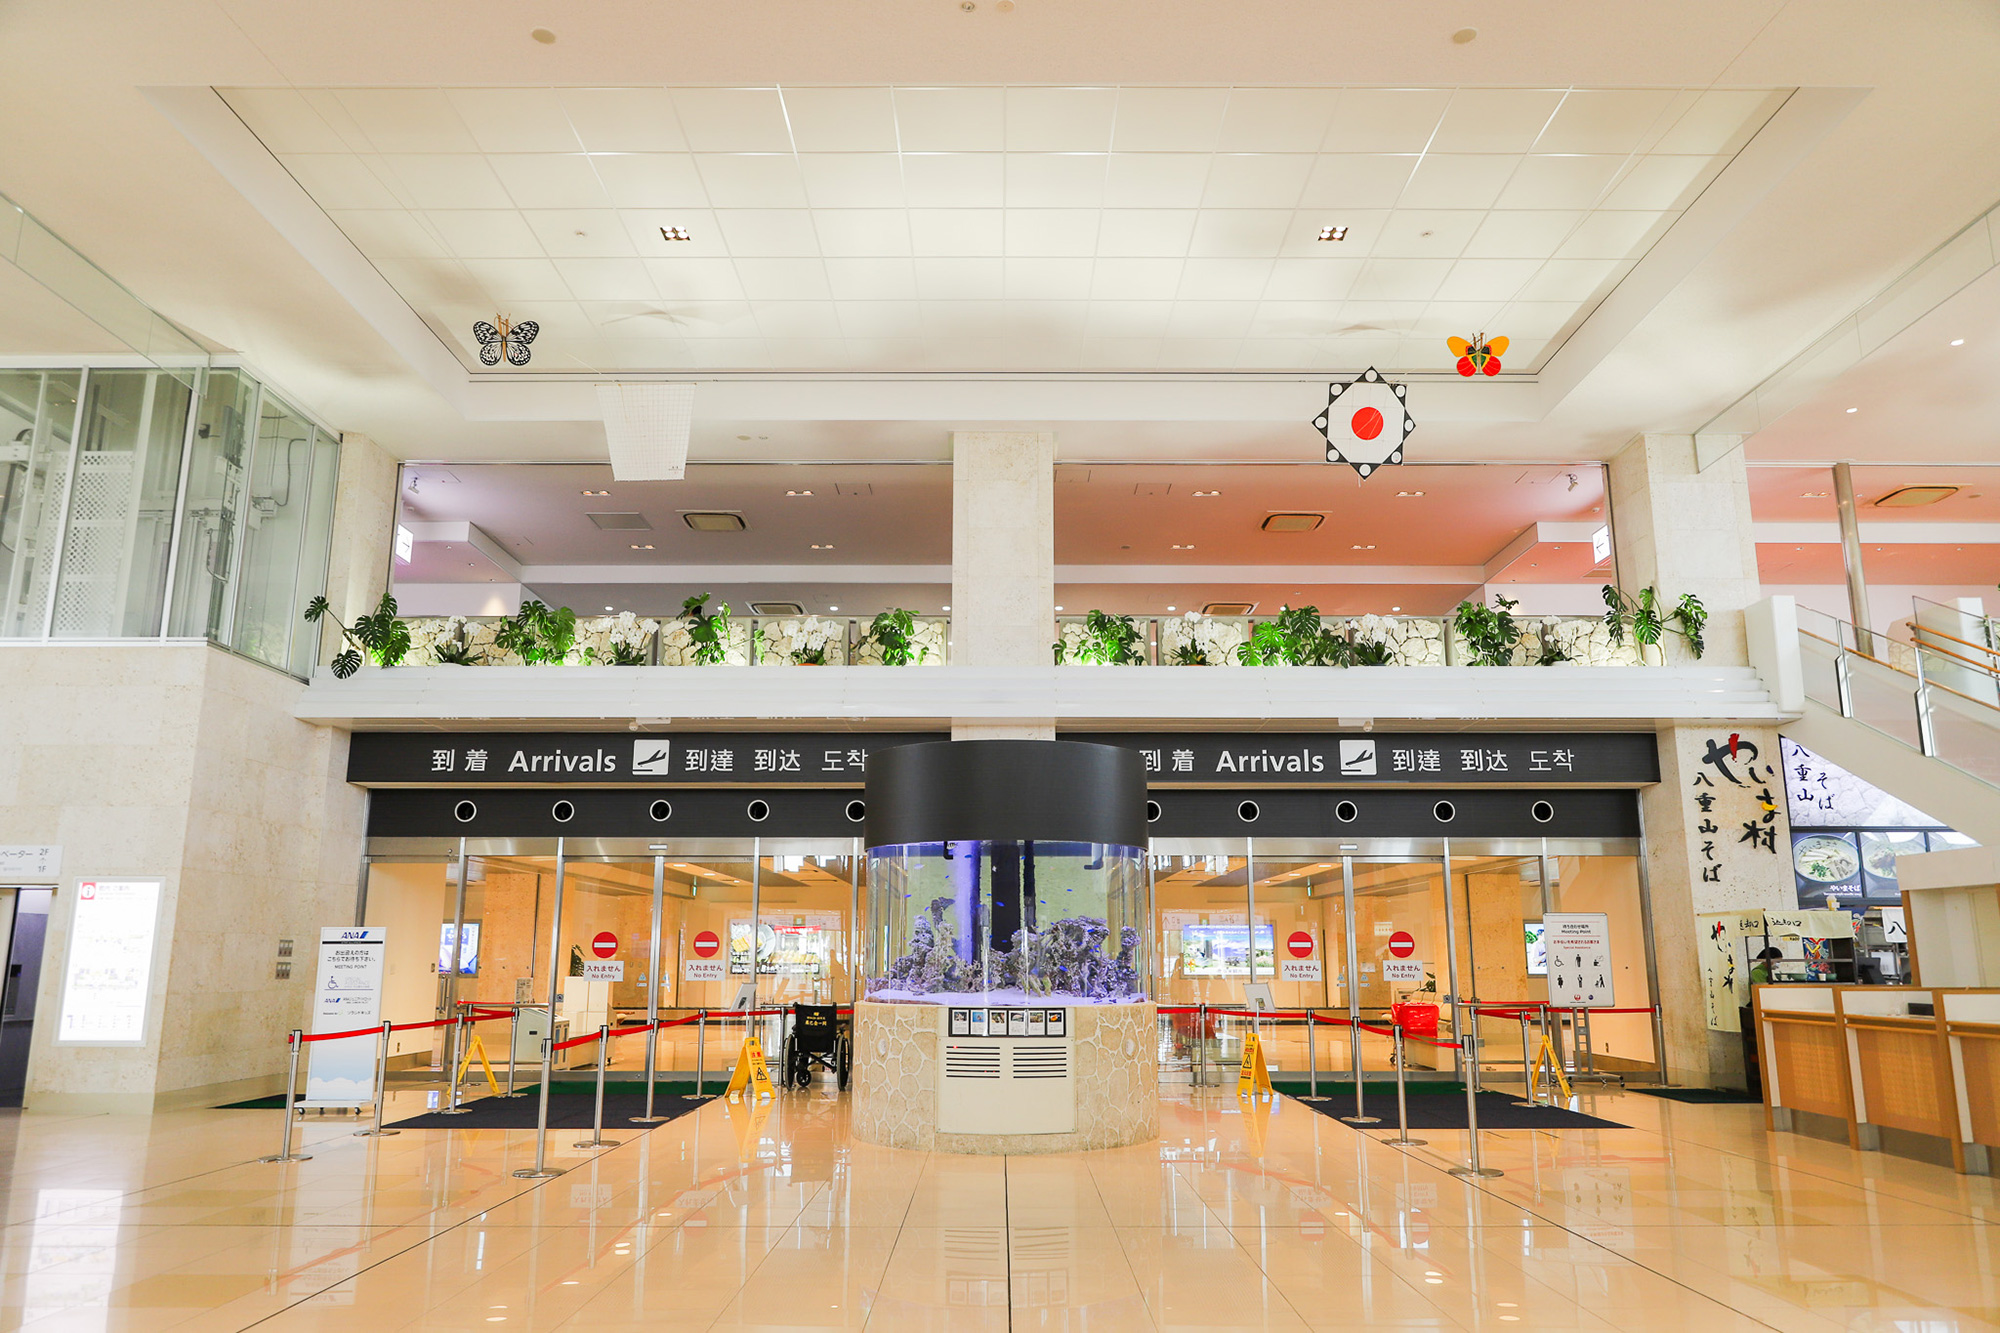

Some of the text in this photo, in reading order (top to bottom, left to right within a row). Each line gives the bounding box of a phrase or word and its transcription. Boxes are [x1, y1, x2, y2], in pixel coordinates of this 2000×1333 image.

[507, 750, 616, 772] Arrivals
[685, 749, 733, 772] 到達
[754, 749, 800, 772] 到达
[821, 749, 868, 772] 도착
[1216, 750, 1324, 772] Arrivals
[1392, 749, 1441, 772] 到達
[1460, 749, 1508, 772] 到达
[1529, 749, 1575, 772] 도착
[1792, 745, 1814, 802] 八重山
[1816, 772, 1835, 810] そば
[1693, 772, 1722, 882] 八重山そば
[40, 848, 49, 856] 2F
[38, 865, 47, 873] 1F
[1830, 884, 1860, 892] やいまそば
[341, 931, 360, 939] ANA
[1284, 964, 1319, 972] 入れません
[1386, 964, 1420, 972] 入れません
